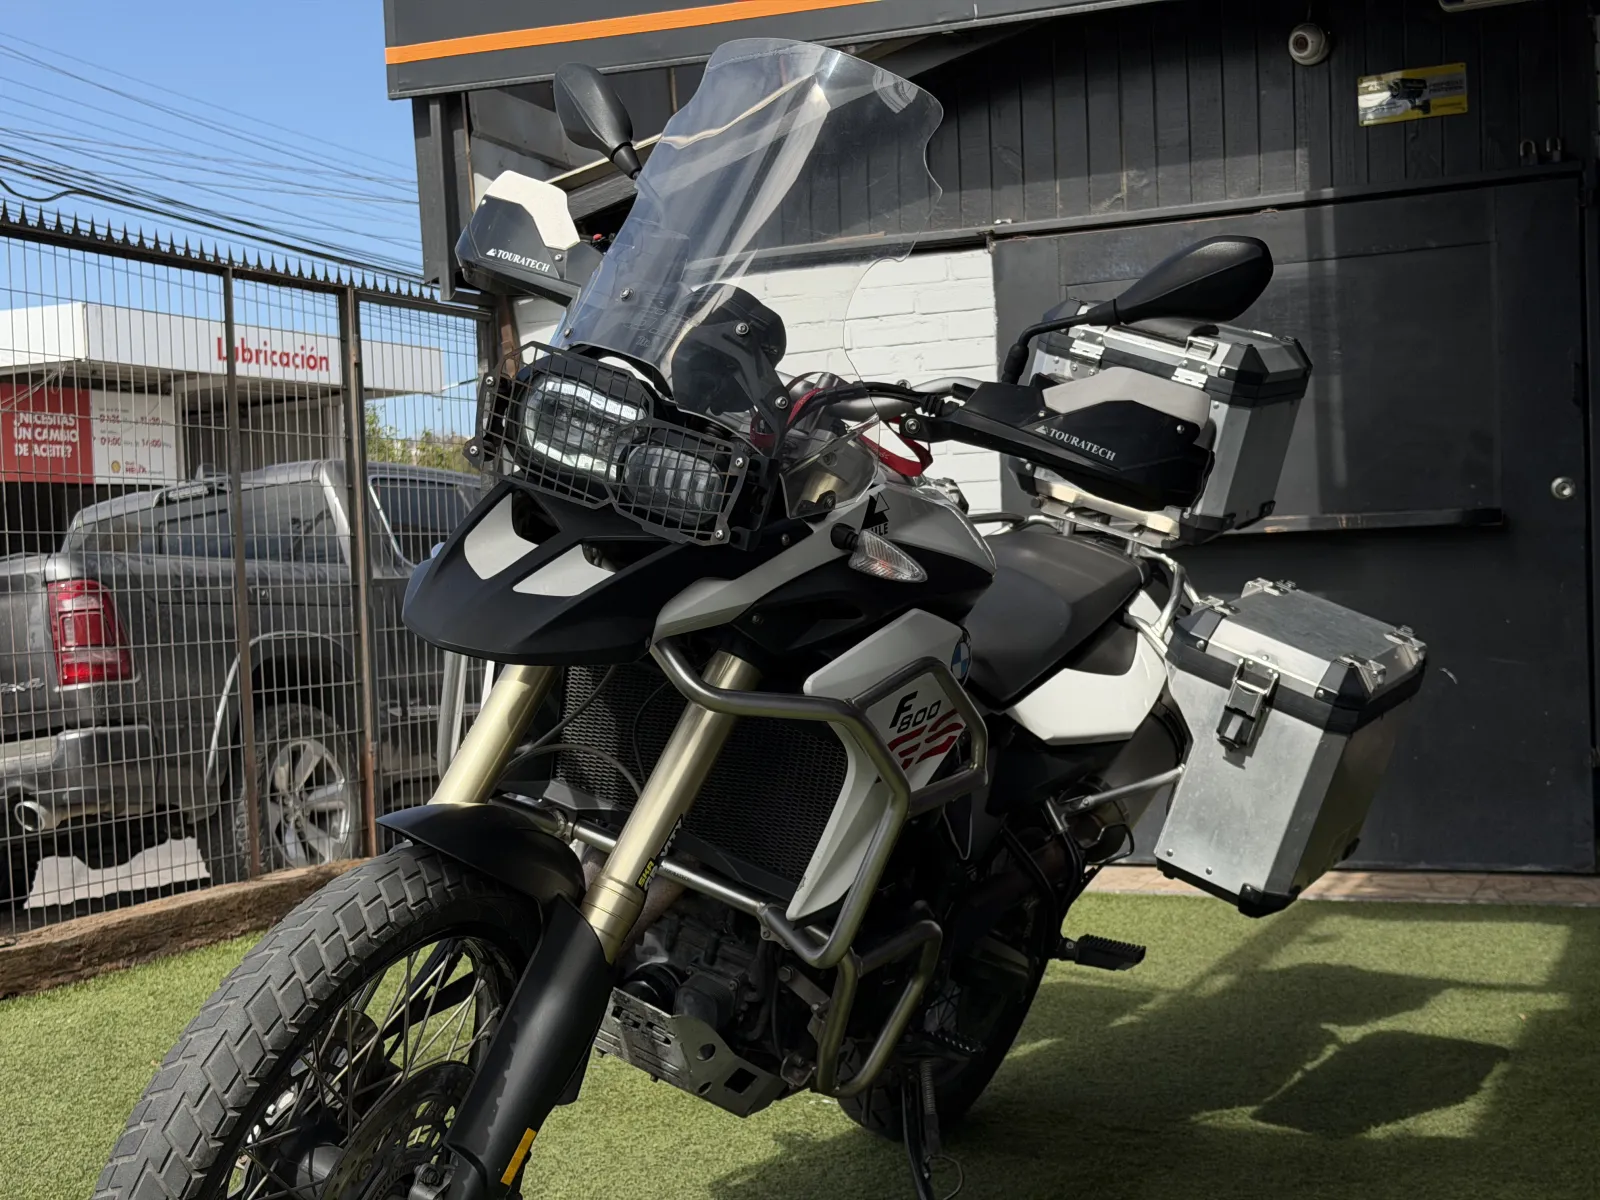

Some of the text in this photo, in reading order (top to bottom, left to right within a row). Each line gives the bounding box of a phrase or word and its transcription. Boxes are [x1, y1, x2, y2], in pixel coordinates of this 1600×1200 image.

[497, 249, 551, 273] TOURATECH
[13, 427, 79, 443] UN CAMBIO
[1049, 428, 1117, 461] TOURATECH
[14, 442, 29, 457] DE
[889, 690, 918, 729] F
[897, 700, 941, 733] 800
